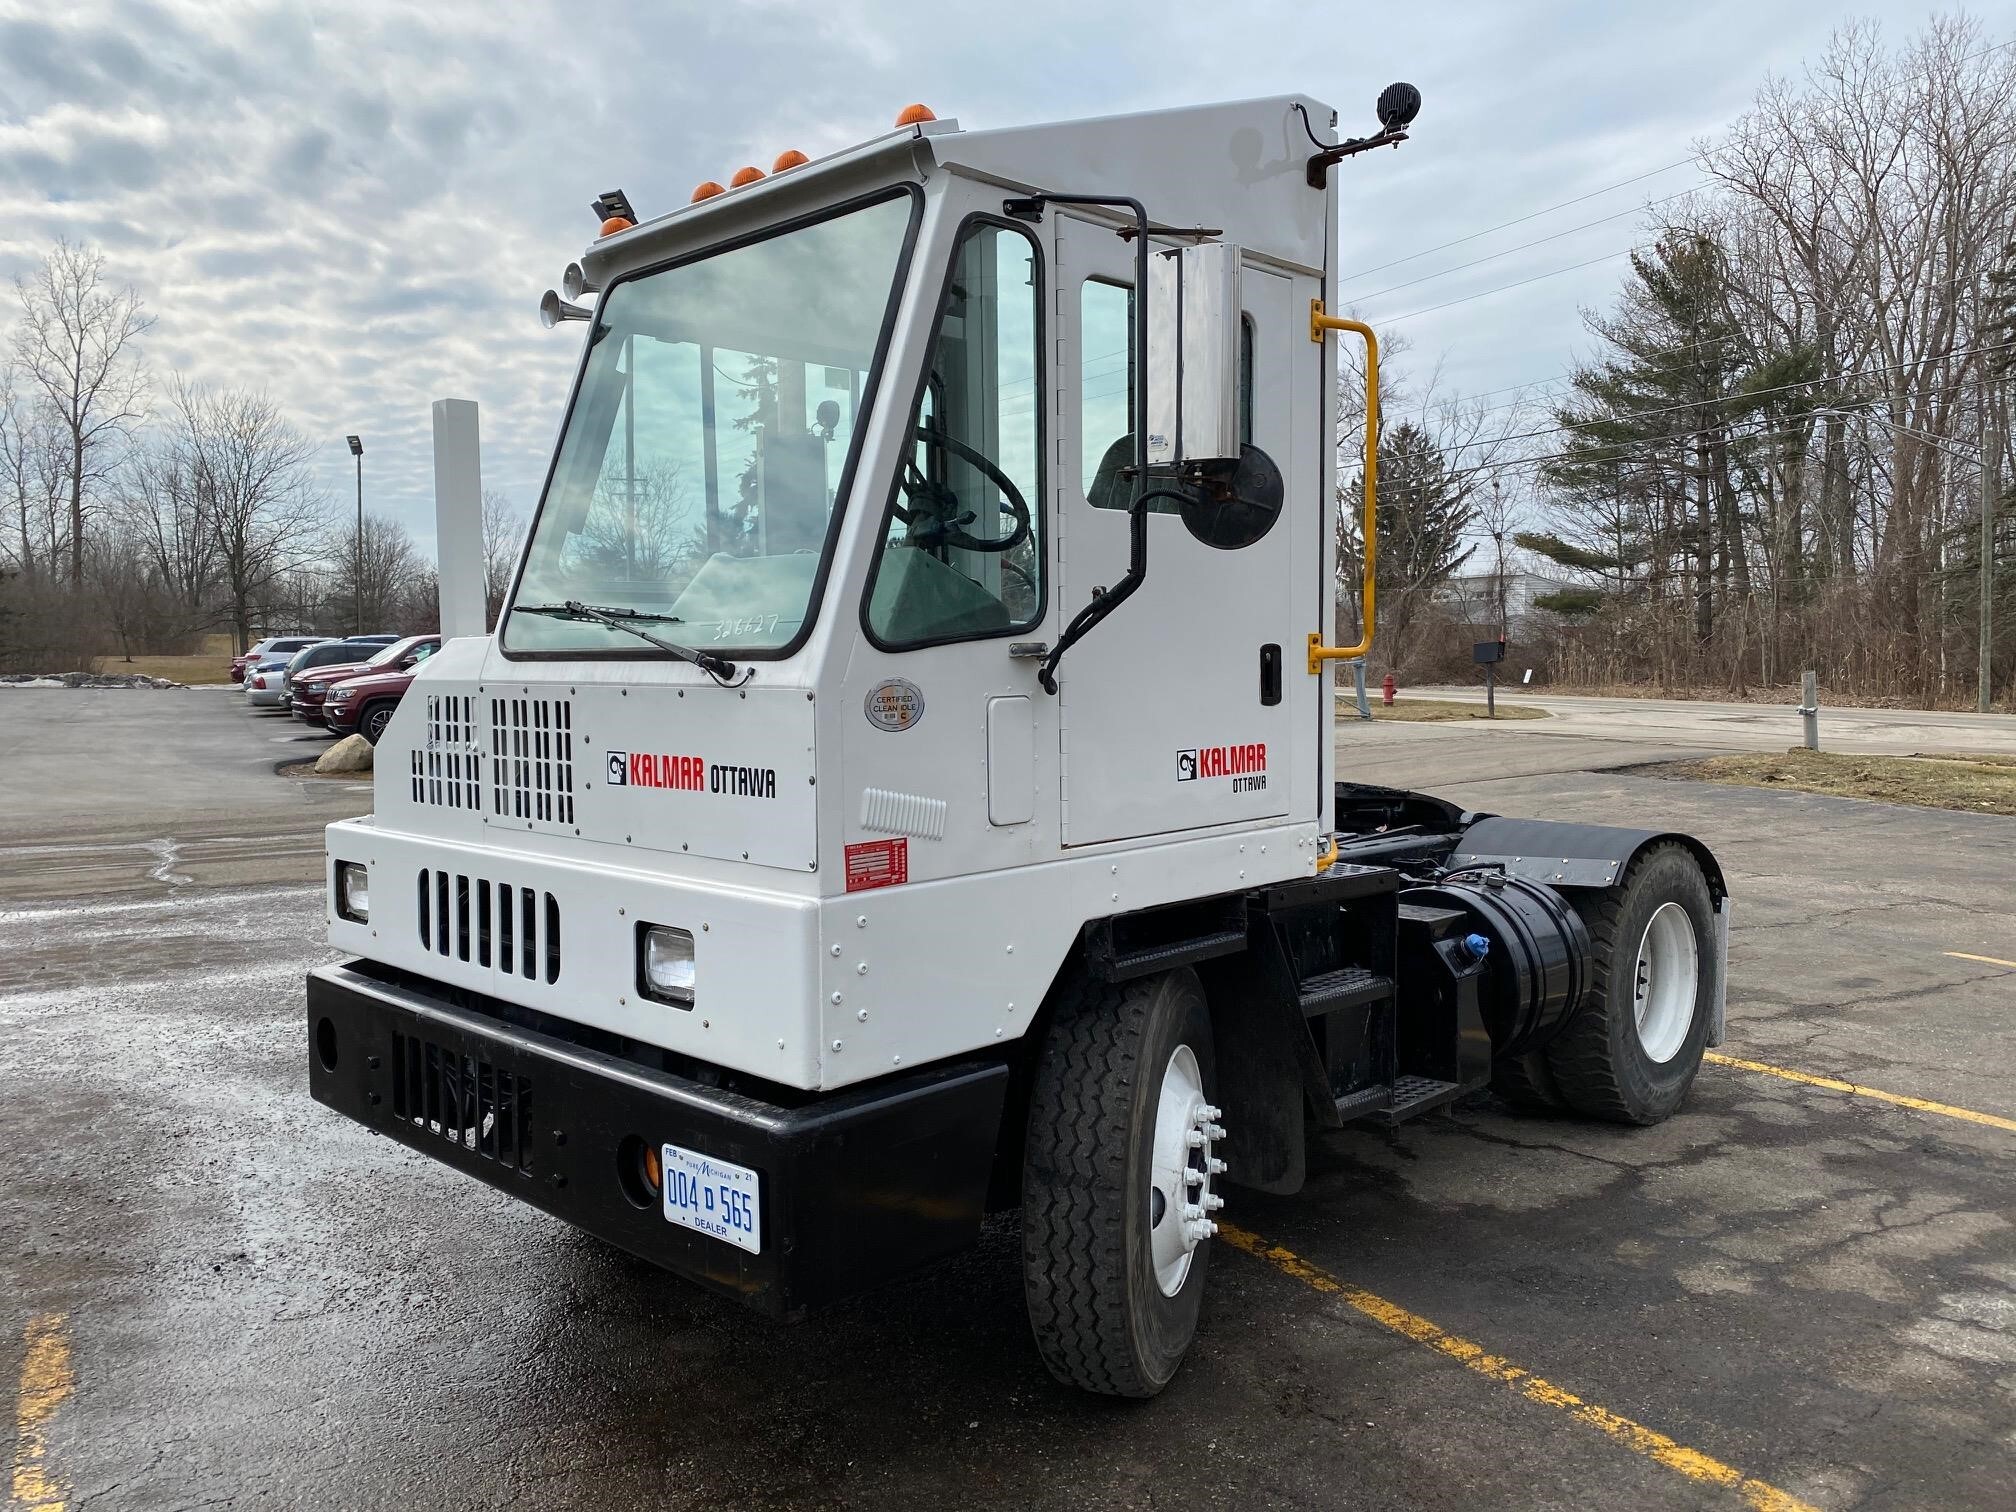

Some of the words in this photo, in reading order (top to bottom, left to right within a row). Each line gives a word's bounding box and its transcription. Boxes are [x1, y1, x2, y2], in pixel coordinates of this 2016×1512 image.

[713, 613, 779, 641] 326627
[873, 704, 898, 713] CLEAN
[900, 703, 916, 711] IDLE
[876, 695, 913, 704] CERTIFIED
[1199, 743, 1267, 778] KALMAR
[629, 753, 704, 792] KALMAR
[710, 764, 776, 799] OTTAWA
[1232, 775, 1267, 794] OTTAWA
[665, 1147, 678, 1158] FEB
[745, 1172, 752, 1182] 21
[667, 1168, 699, 1213] 004
[704, 1186, 714, 1211] D
[719, 1185, 752, 1233] 565
[694, 1217, 728, 1237] DEALER
